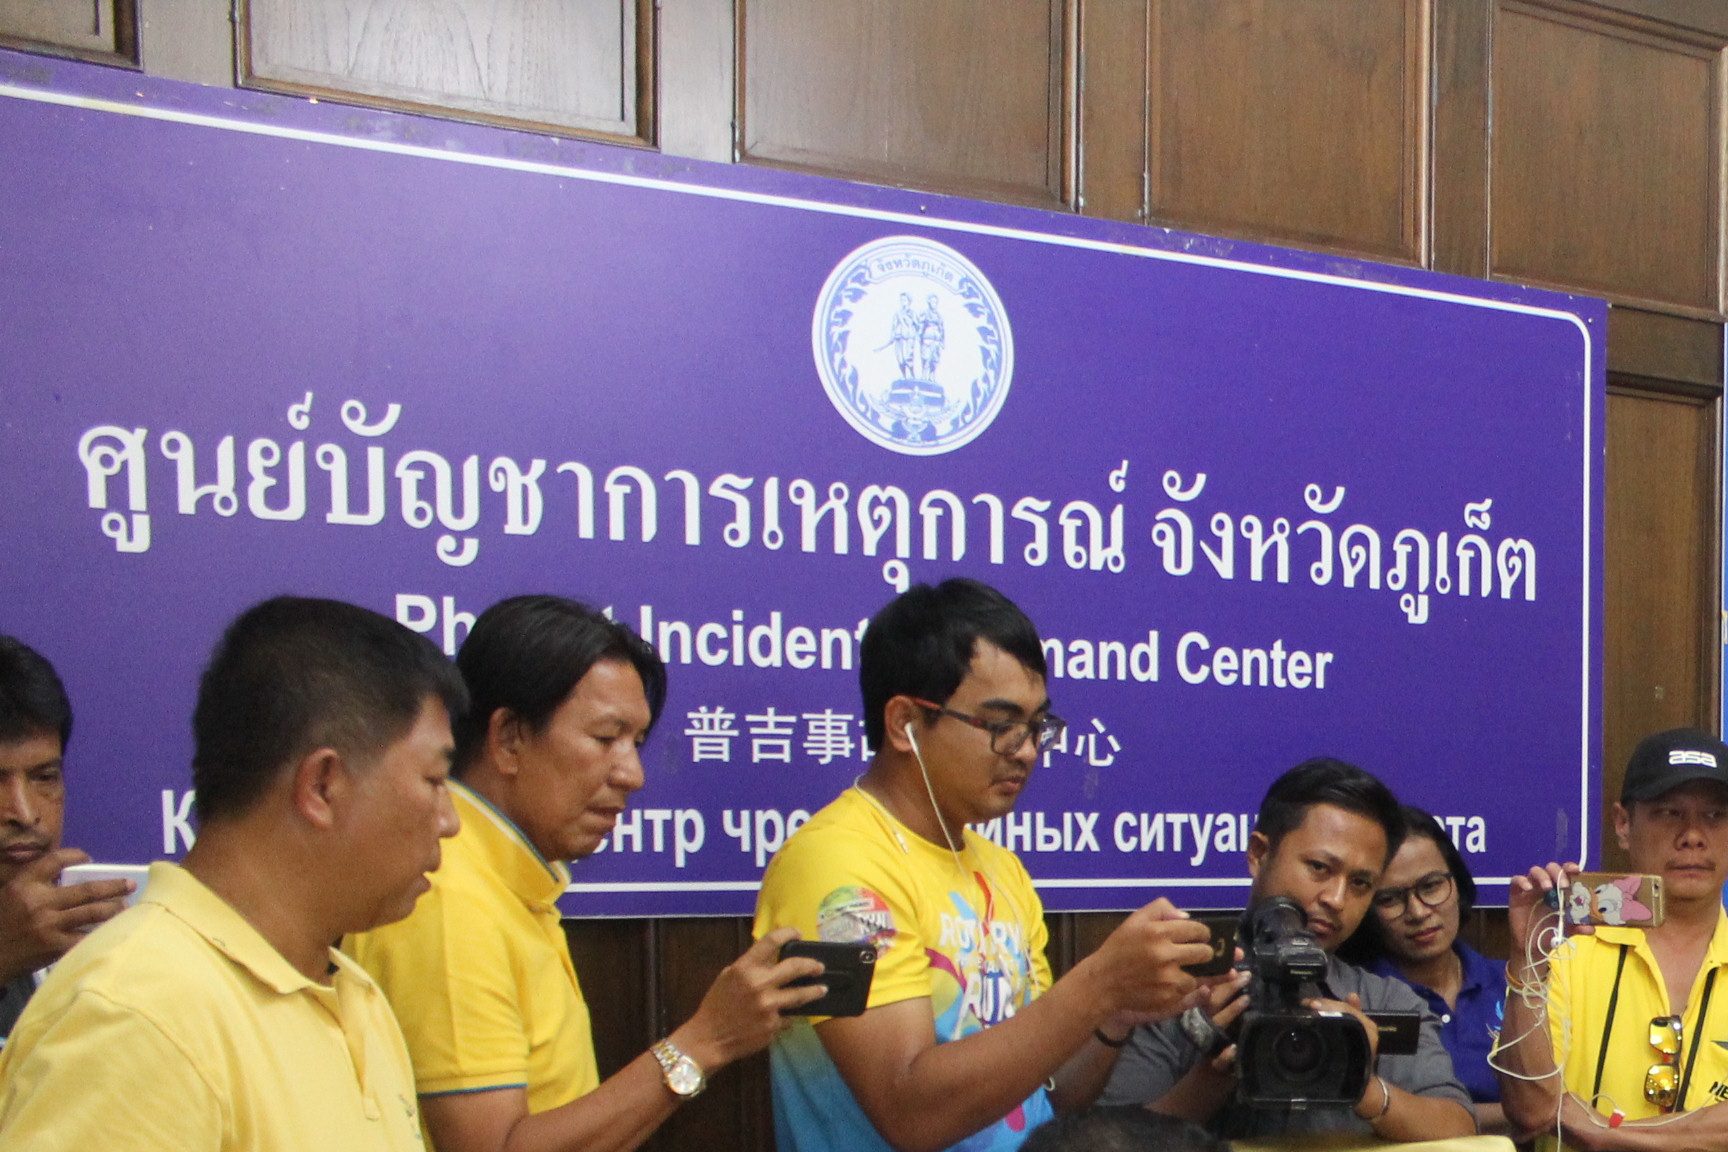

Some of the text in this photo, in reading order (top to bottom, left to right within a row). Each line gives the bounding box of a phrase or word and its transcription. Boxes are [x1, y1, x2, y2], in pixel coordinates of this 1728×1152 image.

[77, 392, 1537, 624] ศูนย์บัญชาการเหตุการณ์ จังหวัดภูเก็ต
[1176, 634, 1333, 690] Center
